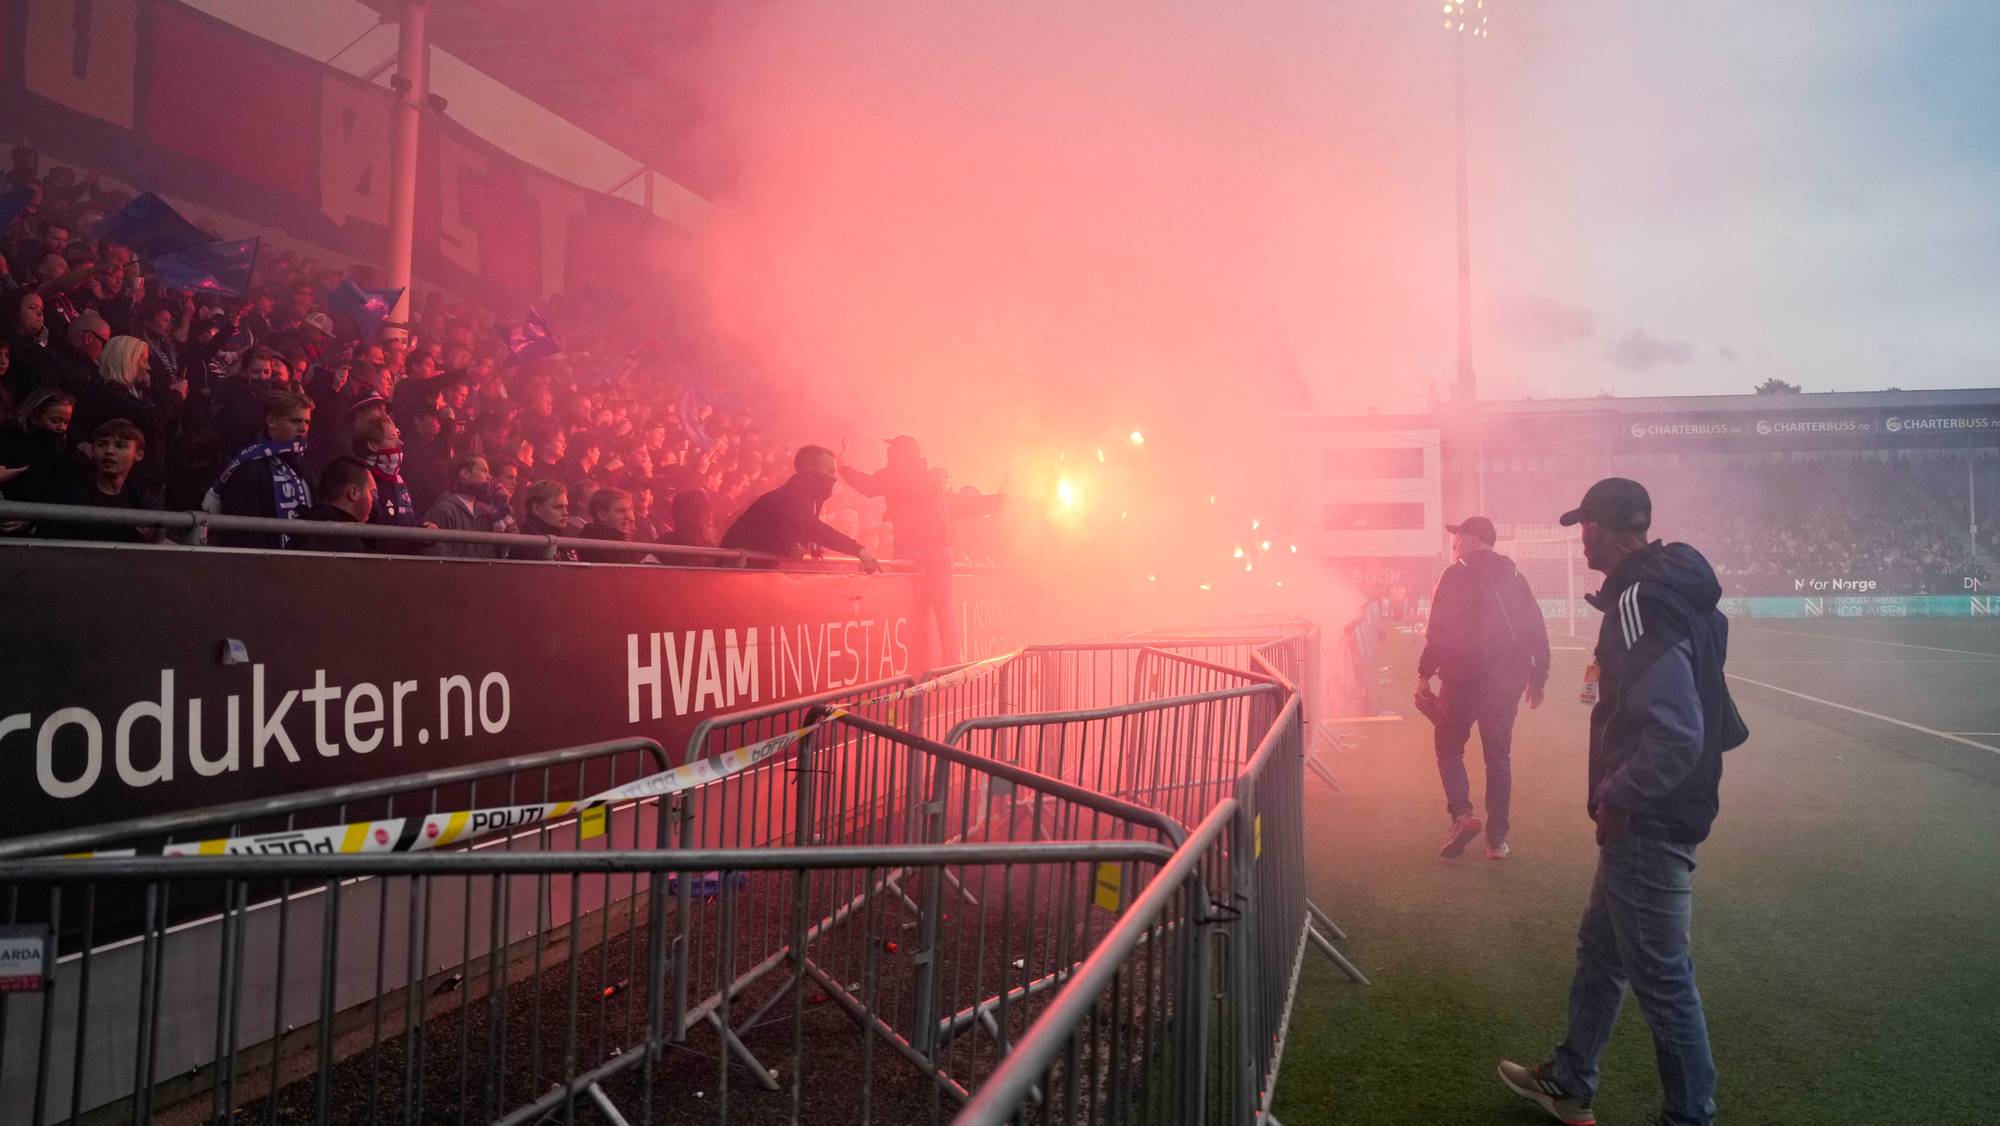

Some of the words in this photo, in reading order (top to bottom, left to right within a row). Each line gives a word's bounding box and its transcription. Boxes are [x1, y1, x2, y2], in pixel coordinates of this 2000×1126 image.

[1773, 421, 1857, 433] CHARTERBUSS
[1903, 417, 1989, 429] CHARTERBUSS
[1647, 424, 1728, 435] CHARTERBUSS
[1809, 578, 1829, 591] for
[1832, 578, 1877, 592] Norge
[627, 627, 759, 723] HVAM
[770, 620, 875, 698] INVEST
[878, 617, 909, 678] AS
[471, 806, 544, 832] POLITI
[1, 949, 40, 960] ARDA
